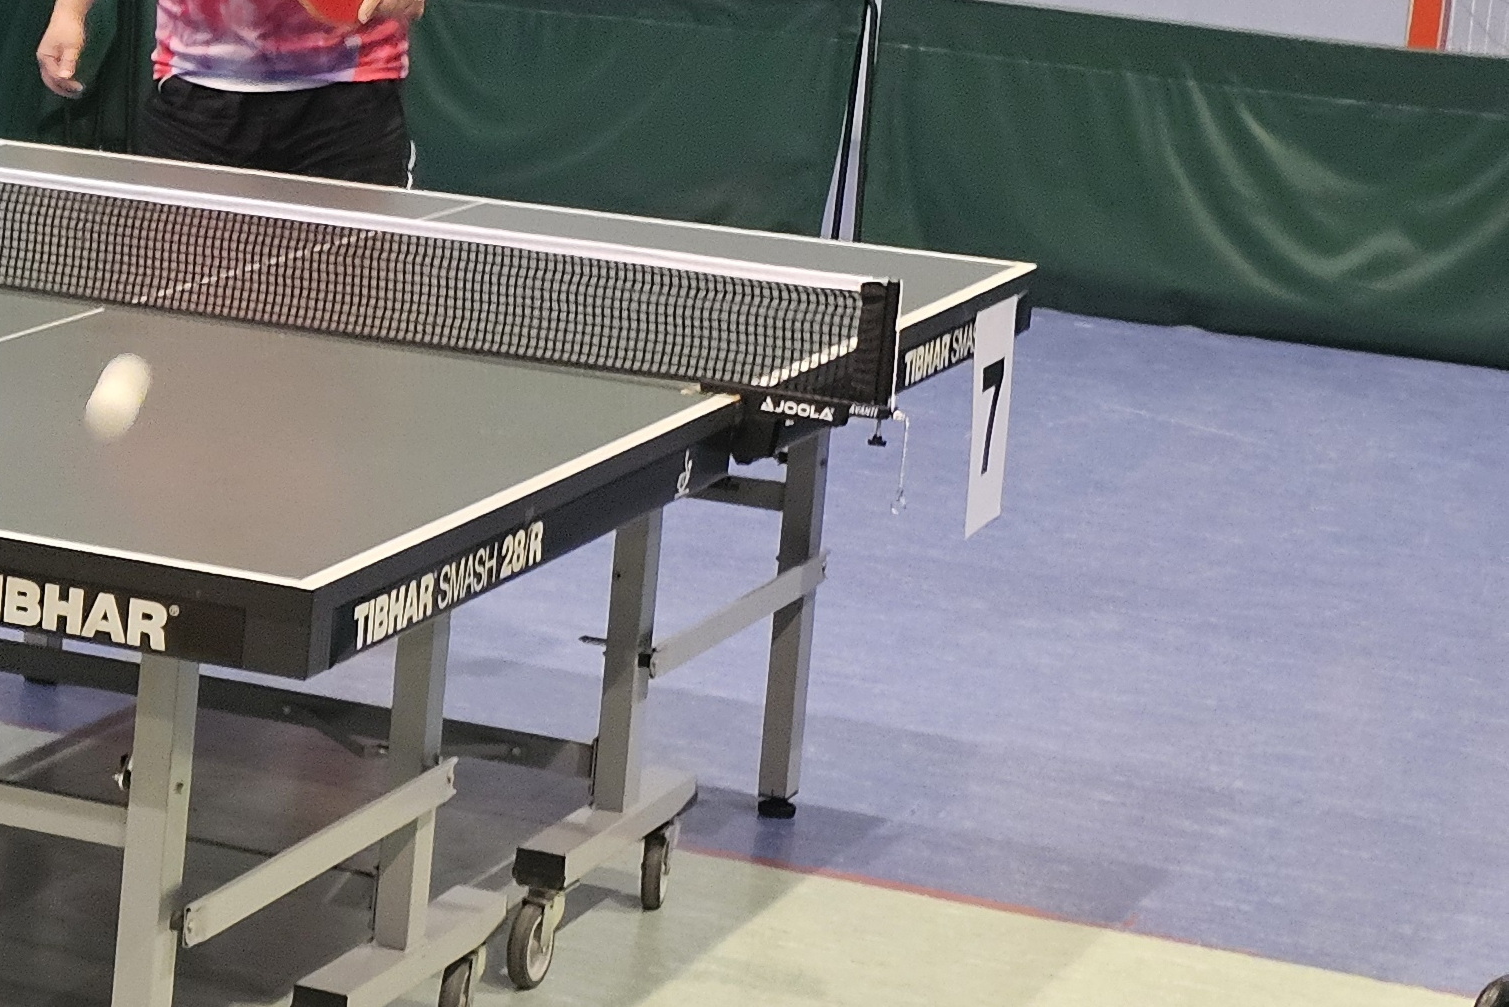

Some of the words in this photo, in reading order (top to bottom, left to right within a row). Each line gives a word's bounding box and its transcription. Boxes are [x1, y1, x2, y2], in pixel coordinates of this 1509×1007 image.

[904, 333, 952, 387] TIBHAR
[774, 400, 834, 422] JOOLA
[980, 357, 1006, 477] 7
[353, 572, 436, 651] TIBHAR
[437, 542, 499, 610] SMASH
[499, 520, 544, 580] 28/R
